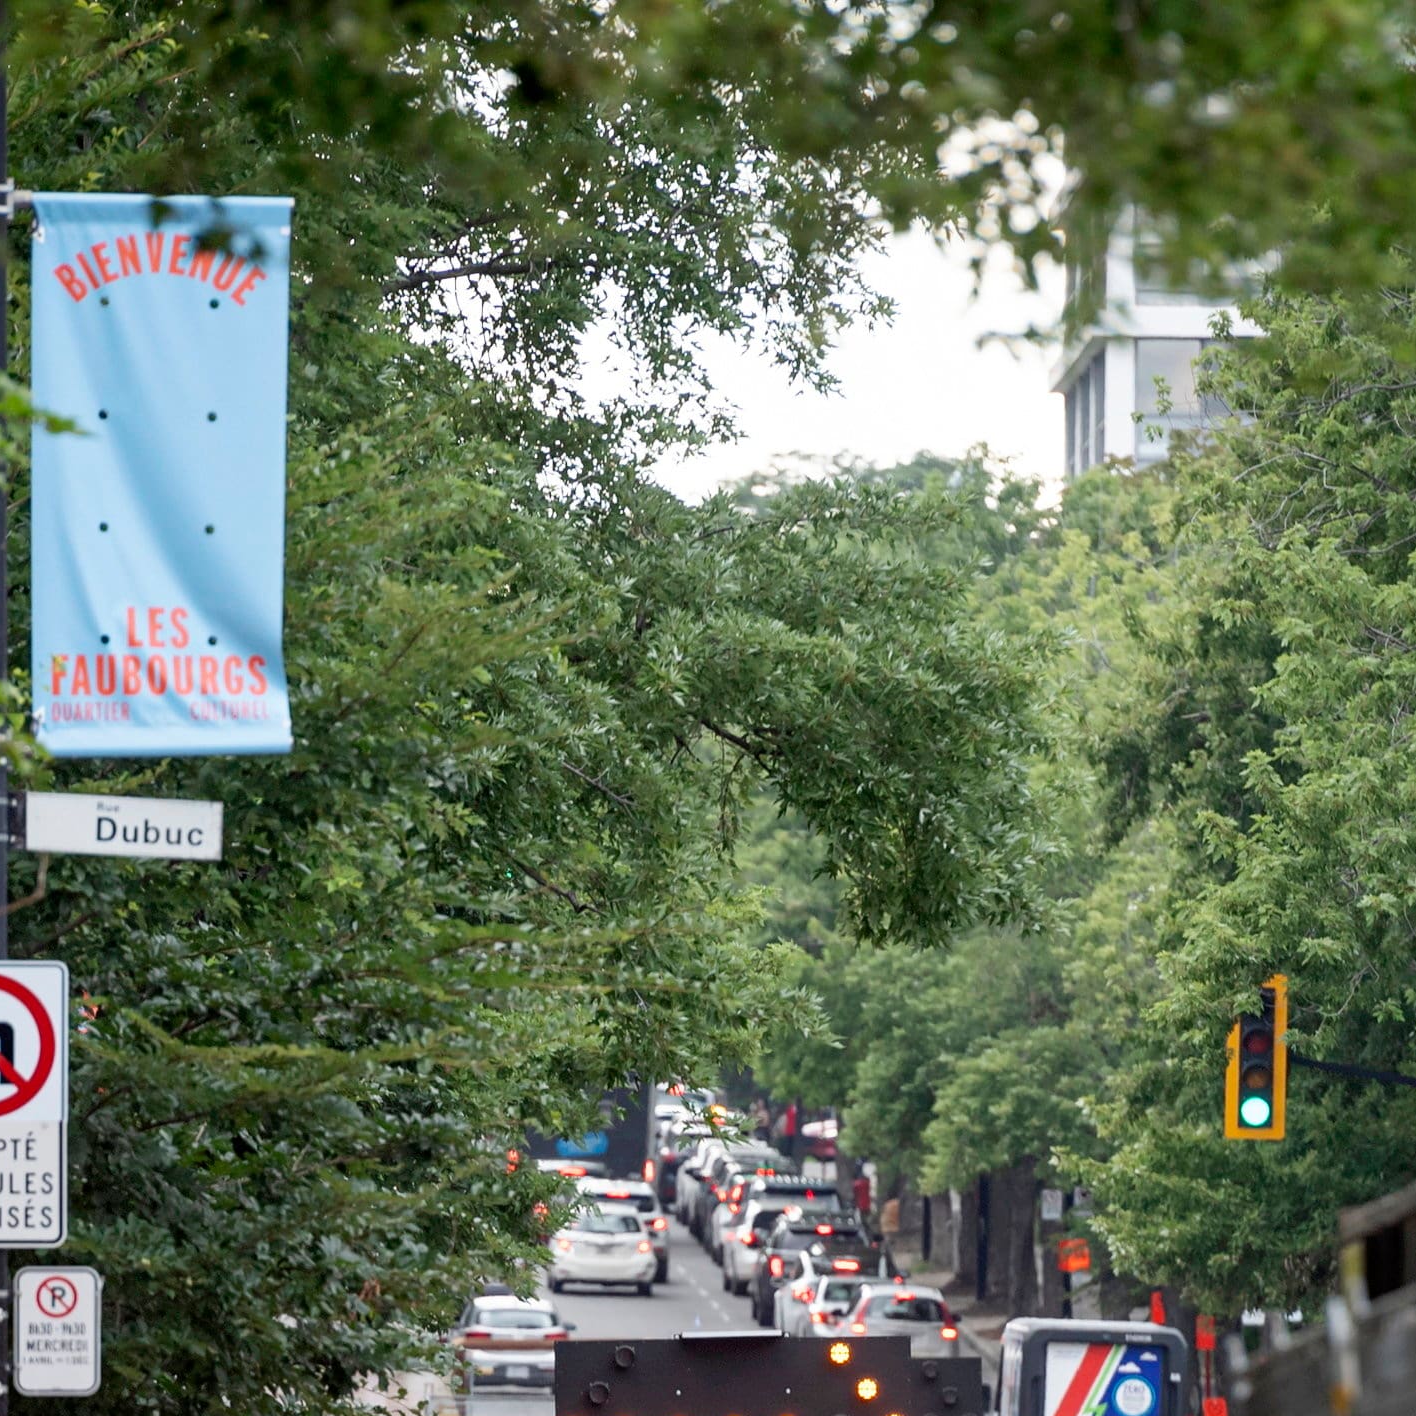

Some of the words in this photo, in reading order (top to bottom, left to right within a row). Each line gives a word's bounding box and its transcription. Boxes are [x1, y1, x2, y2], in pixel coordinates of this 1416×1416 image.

[54, 231, 267, 306] BIENVENUE
[127, 606, 190, 649] LES
[51, 654, 268, 696] FAUBOURGS
[52, 702, 130, 721] QUARTIER
[96, 816, 203, 846] Dubuc
